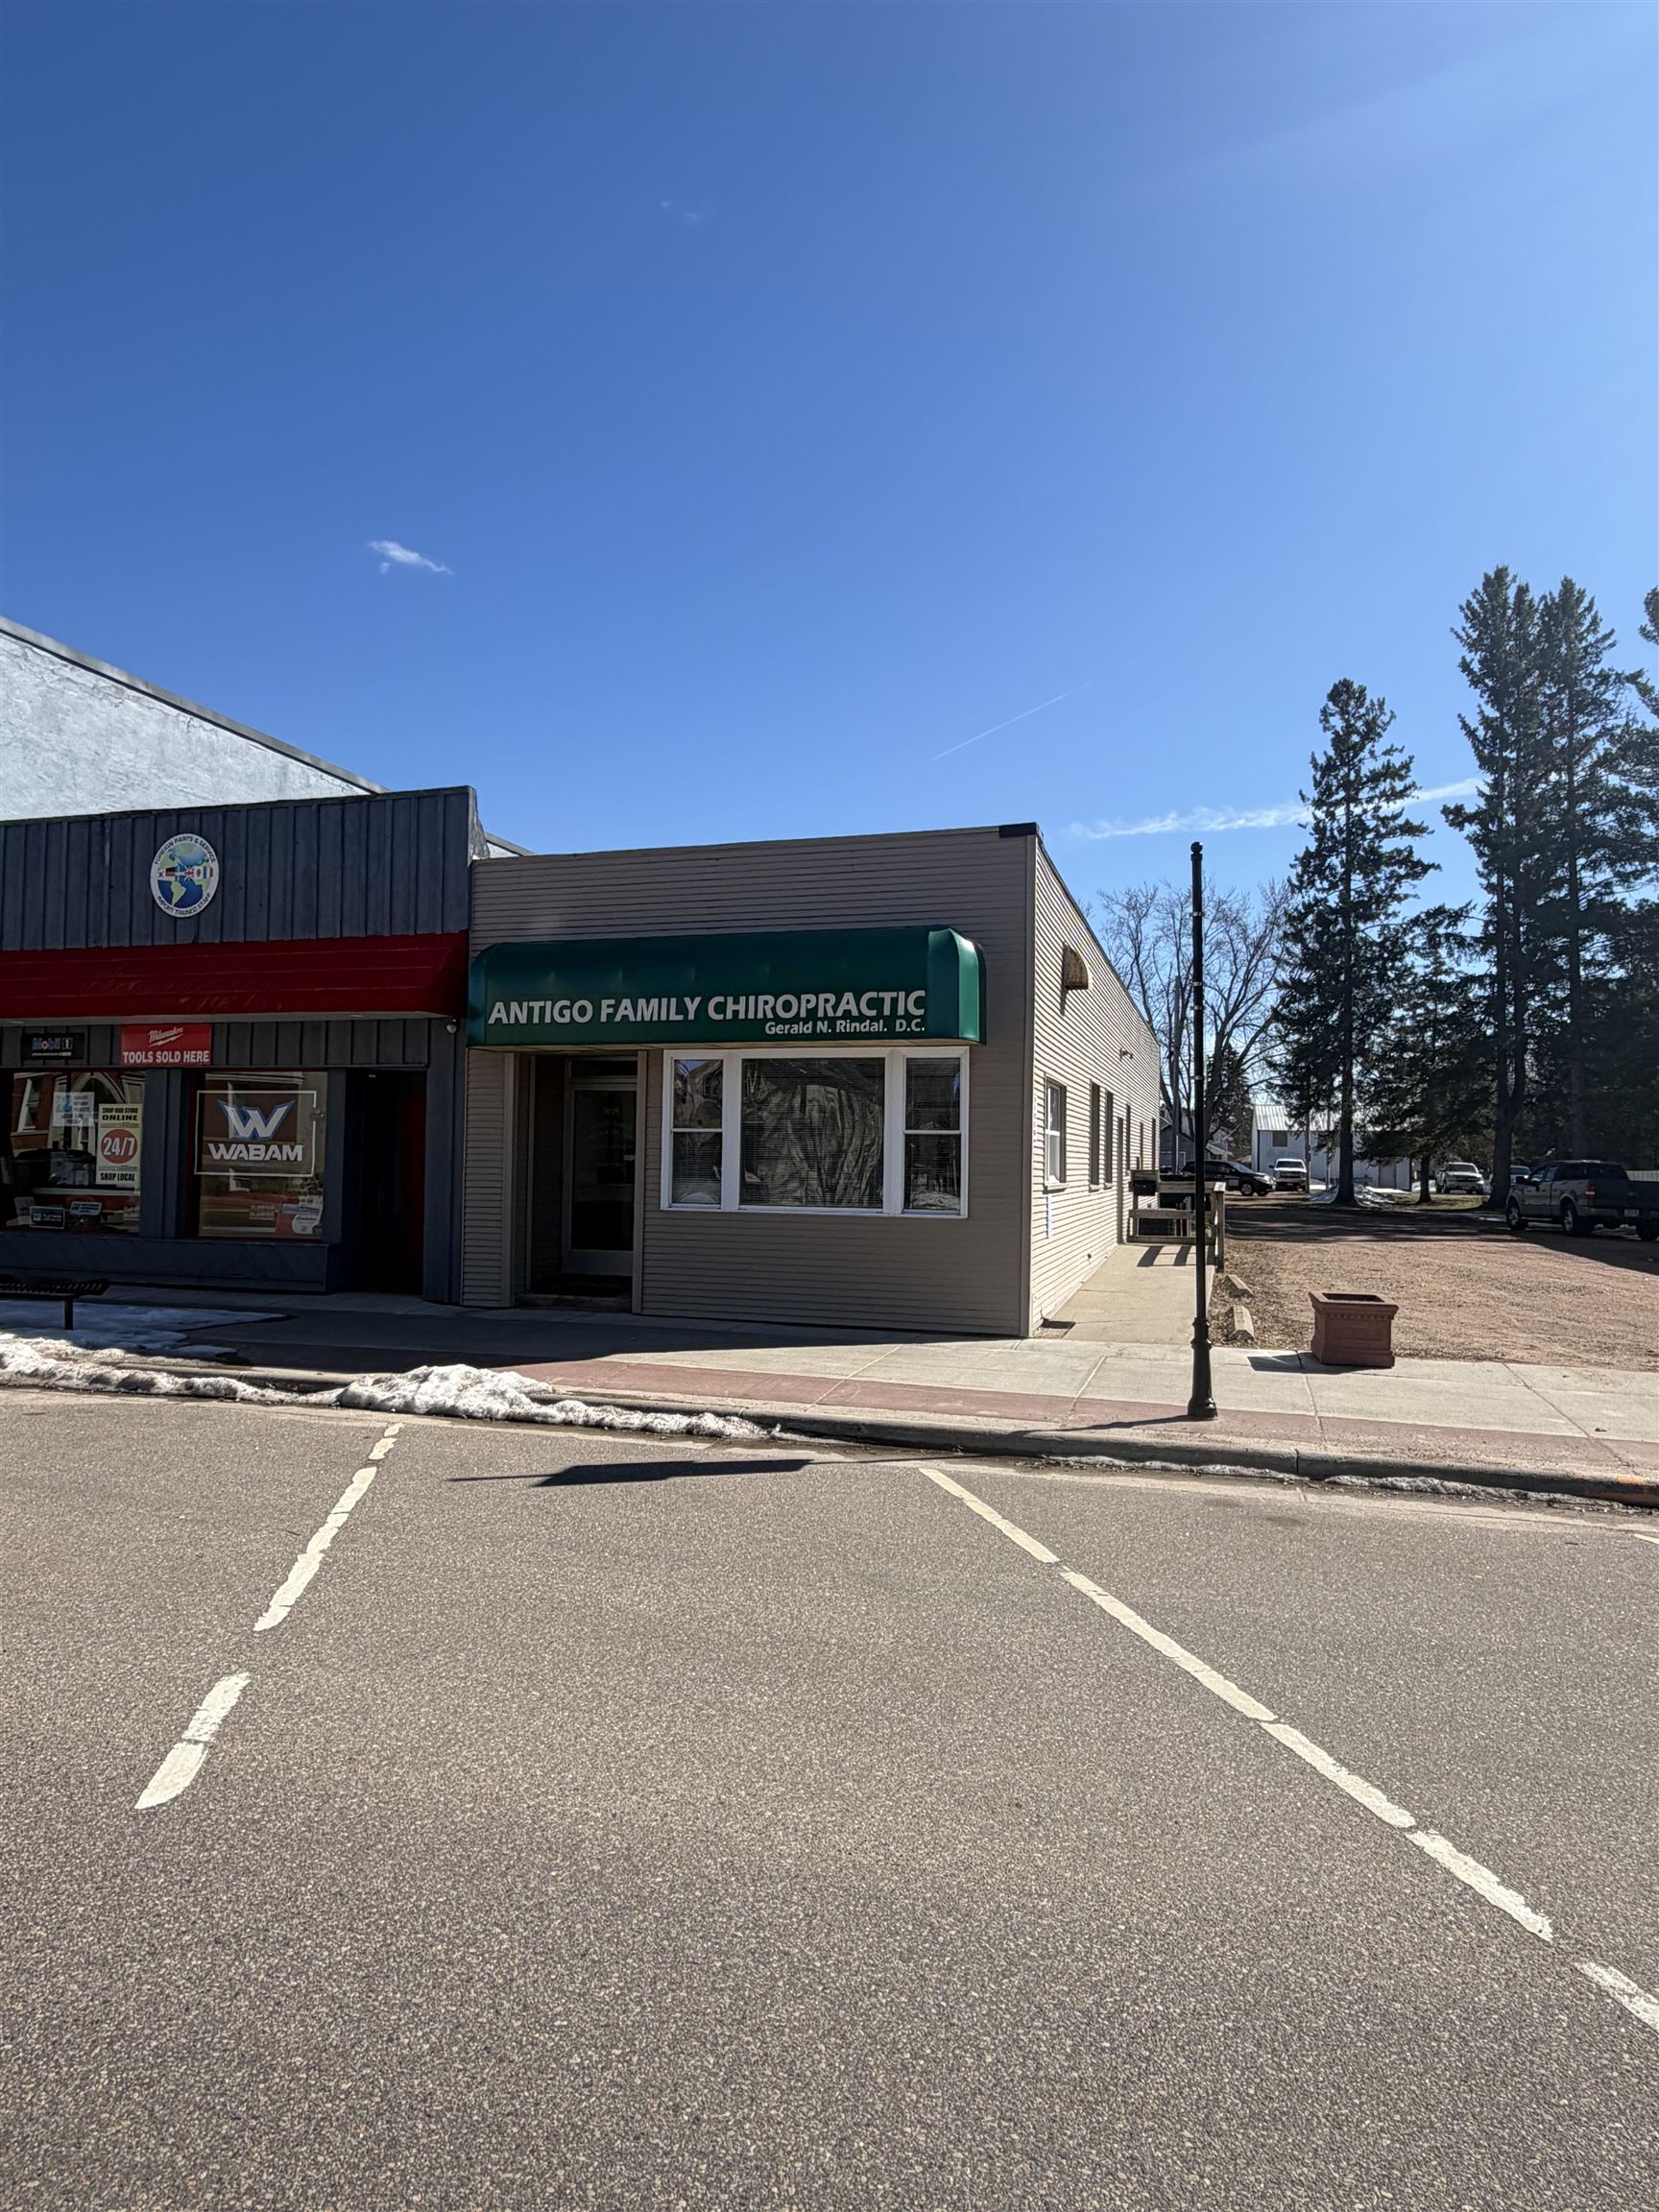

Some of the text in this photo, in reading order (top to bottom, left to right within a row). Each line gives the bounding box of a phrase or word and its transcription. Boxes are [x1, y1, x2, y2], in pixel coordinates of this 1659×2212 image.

[174, 835, 194, 844] PARTS
[488, 990, 926, 1024] ANTIGO FAMILY CHIROPRACTIC
[765, 1022, 812, 1035] Gerald
[816, 1021, 831, 1034] N.
[895, 1019, 926, 1032] D.C.
[32, 1037, 60, 1050] Mobil
[123, 1050, 209, 1064] TOOLS SOLD HERE
[103, 1137, 135, 1156] 24/7
[208, 1142, 305, 1162] WABAM
[100, 1172, 135, 1182] SHOP LOCAL
